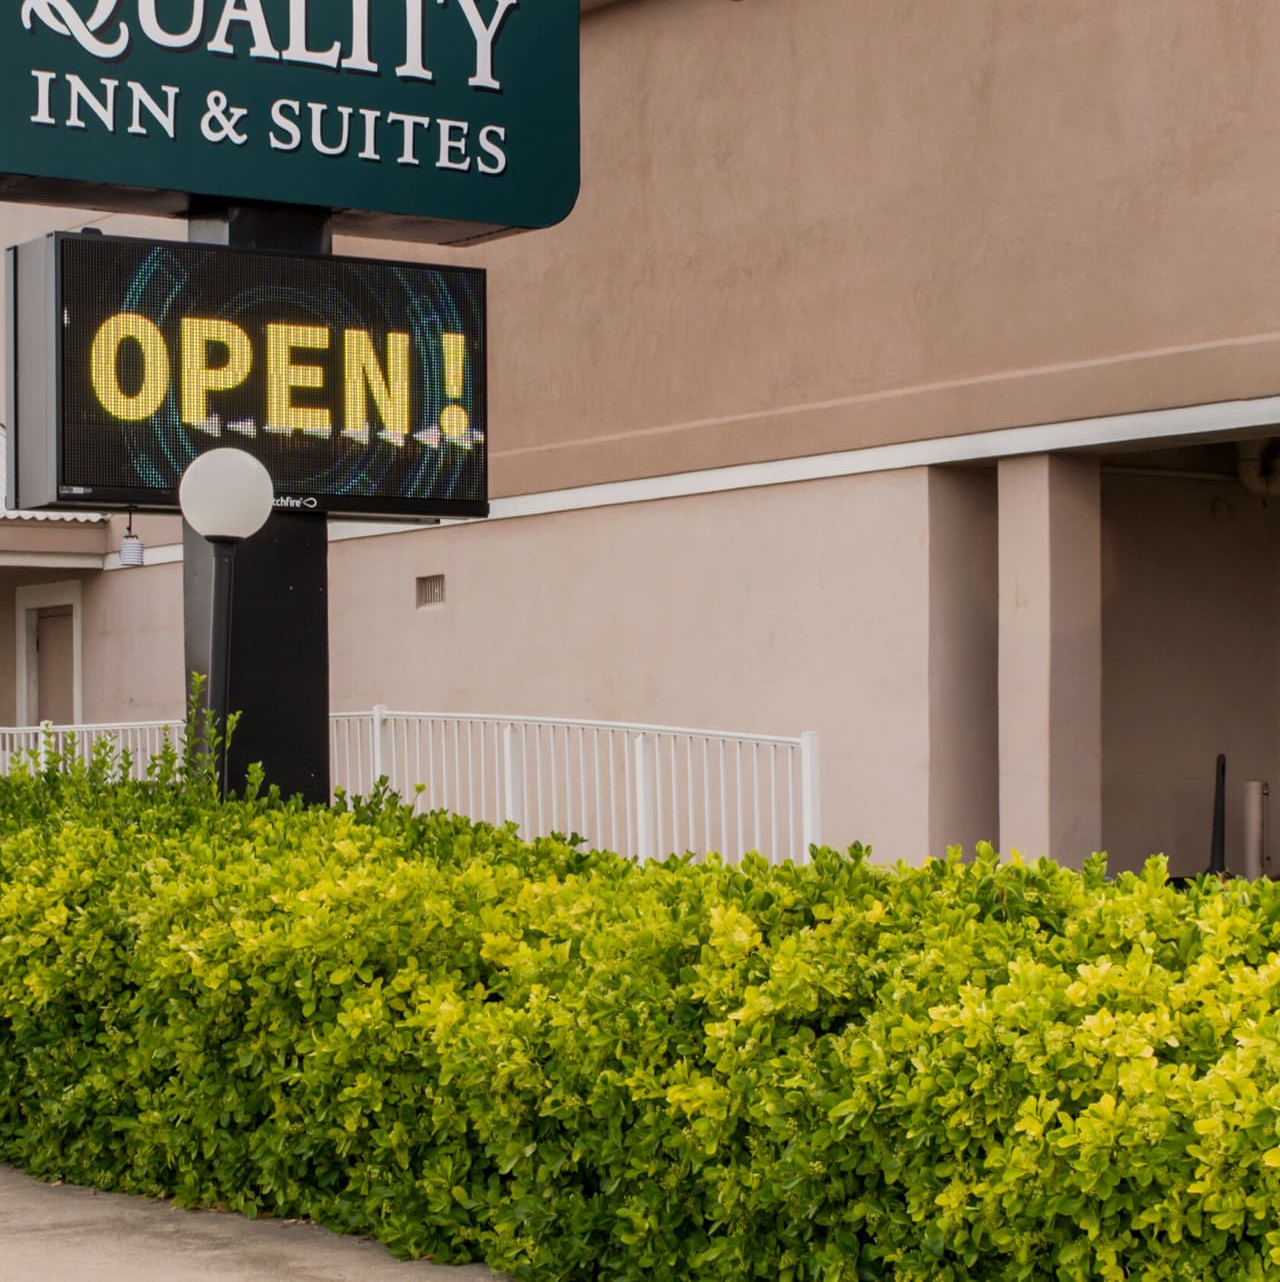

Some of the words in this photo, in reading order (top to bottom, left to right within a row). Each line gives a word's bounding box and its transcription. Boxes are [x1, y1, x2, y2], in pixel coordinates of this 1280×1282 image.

[30, 69, 180, 139] INN
[199, 89, 249, 145] &
[269, 98, 508, 175] SUITES
[90, 312, 469, 438] OPEN!
